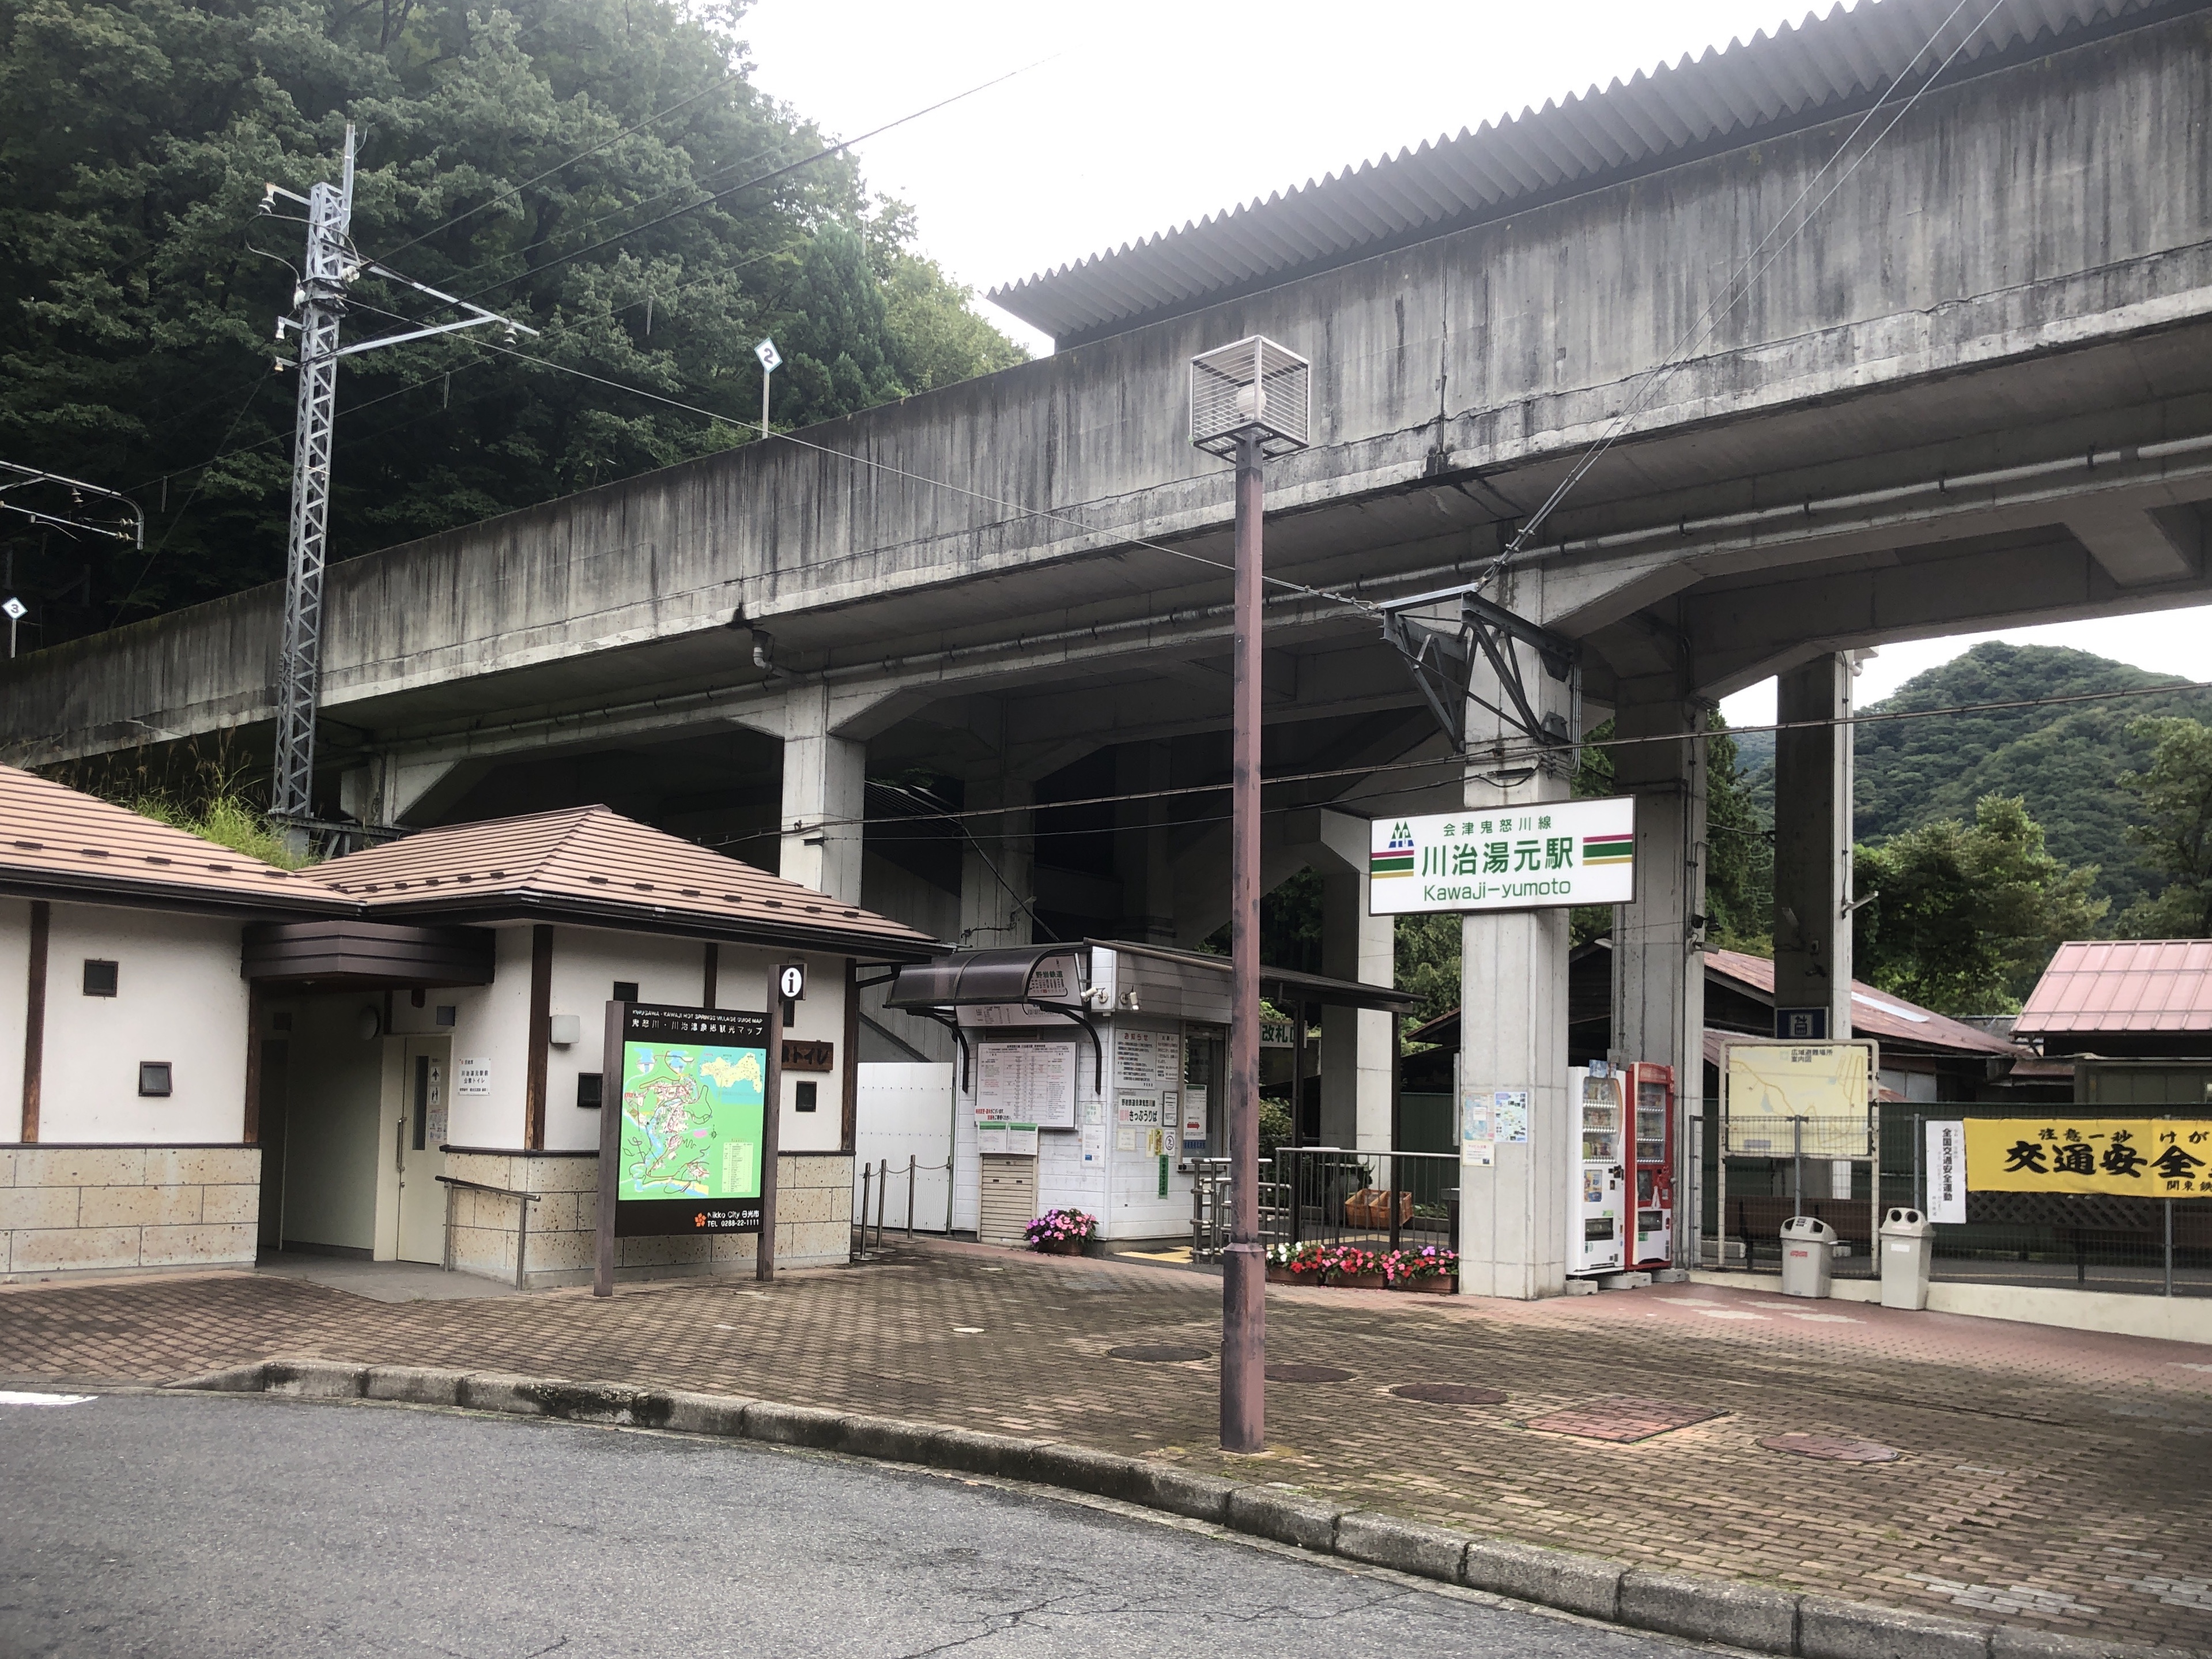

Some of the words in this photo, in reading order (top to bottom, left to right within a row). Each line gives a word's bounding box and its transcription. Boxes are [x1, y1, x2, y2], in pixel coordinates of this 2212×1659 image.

[764, 348, 773, 365] 2
[10, 604, 20, 613] 3
[1443, 816, 1552, 837] 会津鬼怒川線
[1422, 836, 1573, 877] 川治湯元駅
[1424, 878, 1571, 902] Kawaji-yumoto
[2038, 1128, 2133, 1143] 注意一秒
[1942, 1128, 1952, 1201] 全国交通安全運動
[2003, 1141, 2212, 1179] 交通安全
[721, 1219, 759, 1227] 0288-22-1111
[727, 1211, 739, 1219] City
